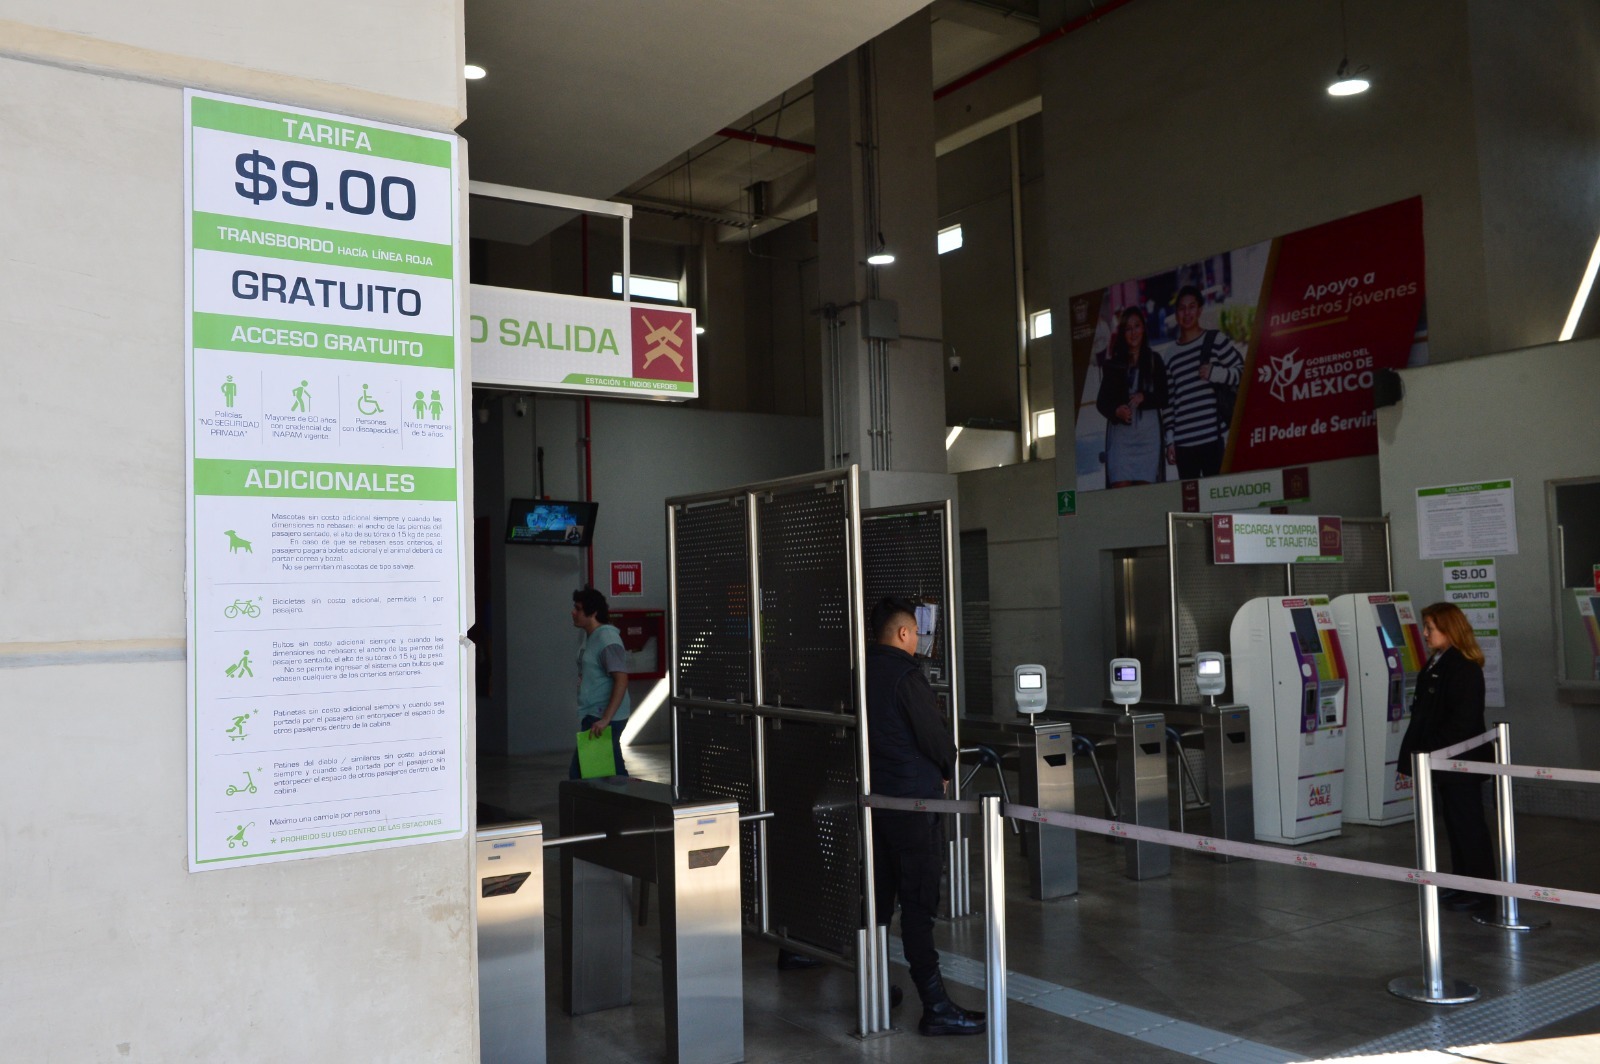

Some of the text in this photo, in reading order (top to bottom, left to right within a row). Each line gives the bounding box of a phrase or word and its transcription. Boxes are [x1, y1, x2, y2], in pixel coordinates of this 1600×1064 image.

[283, 118, 372, 151] TARIFA
[235, 150, 416, 221] $9.00
[217, 226, 433, 266] TRANSBORDO HACÍA LÍNEA ROJA
[232, 270, 421, 316] GRATUITO
[1304, 272, 1375, 300] Apoyo a
[1270, 282, 1417, 326] nuestros jóvenes
[231, 326, 423, 357] ACCESO GRATUITO
[500, 319, 619, 355] SALIDA
[1305, 356, 1373, 379] ESTADO DE
[1306, 348, 1369, 366] GOBIERNO DEL
[586, 377, 620, 386] ESTACIÓN
[653, 382, 677, 390] VERDES
[1292, 370, 1373, 400] MÉXICO
[215, 420, 259, 428] SEGURIDAD
[265, 414, 296, 422] Mayores
[356, 418, 386, 426] Personas
[1250, 427, 1266, 447] ¡El
[1270, 424, 1307, 441] Poder
[1311, 419, 1327, 434] de
[245, 468, 414, 492] ADICIONALES
[1210, 482, 1271, 499] ELEVADOR
[1234, 524, 1317, 535] RECARGA Y COMPRA
[1266, 537, 1318, 548] DE TARJETAS
[1452, 568, 1487, 580] $9.00
[1452, 591, 1489, 600] GRATUITO
[1308, 795, 1331, 807] CABLE
[280, 819, 443, 843] PROHIBIDO SU USO DENTRO DE LAS ESTACIONES
